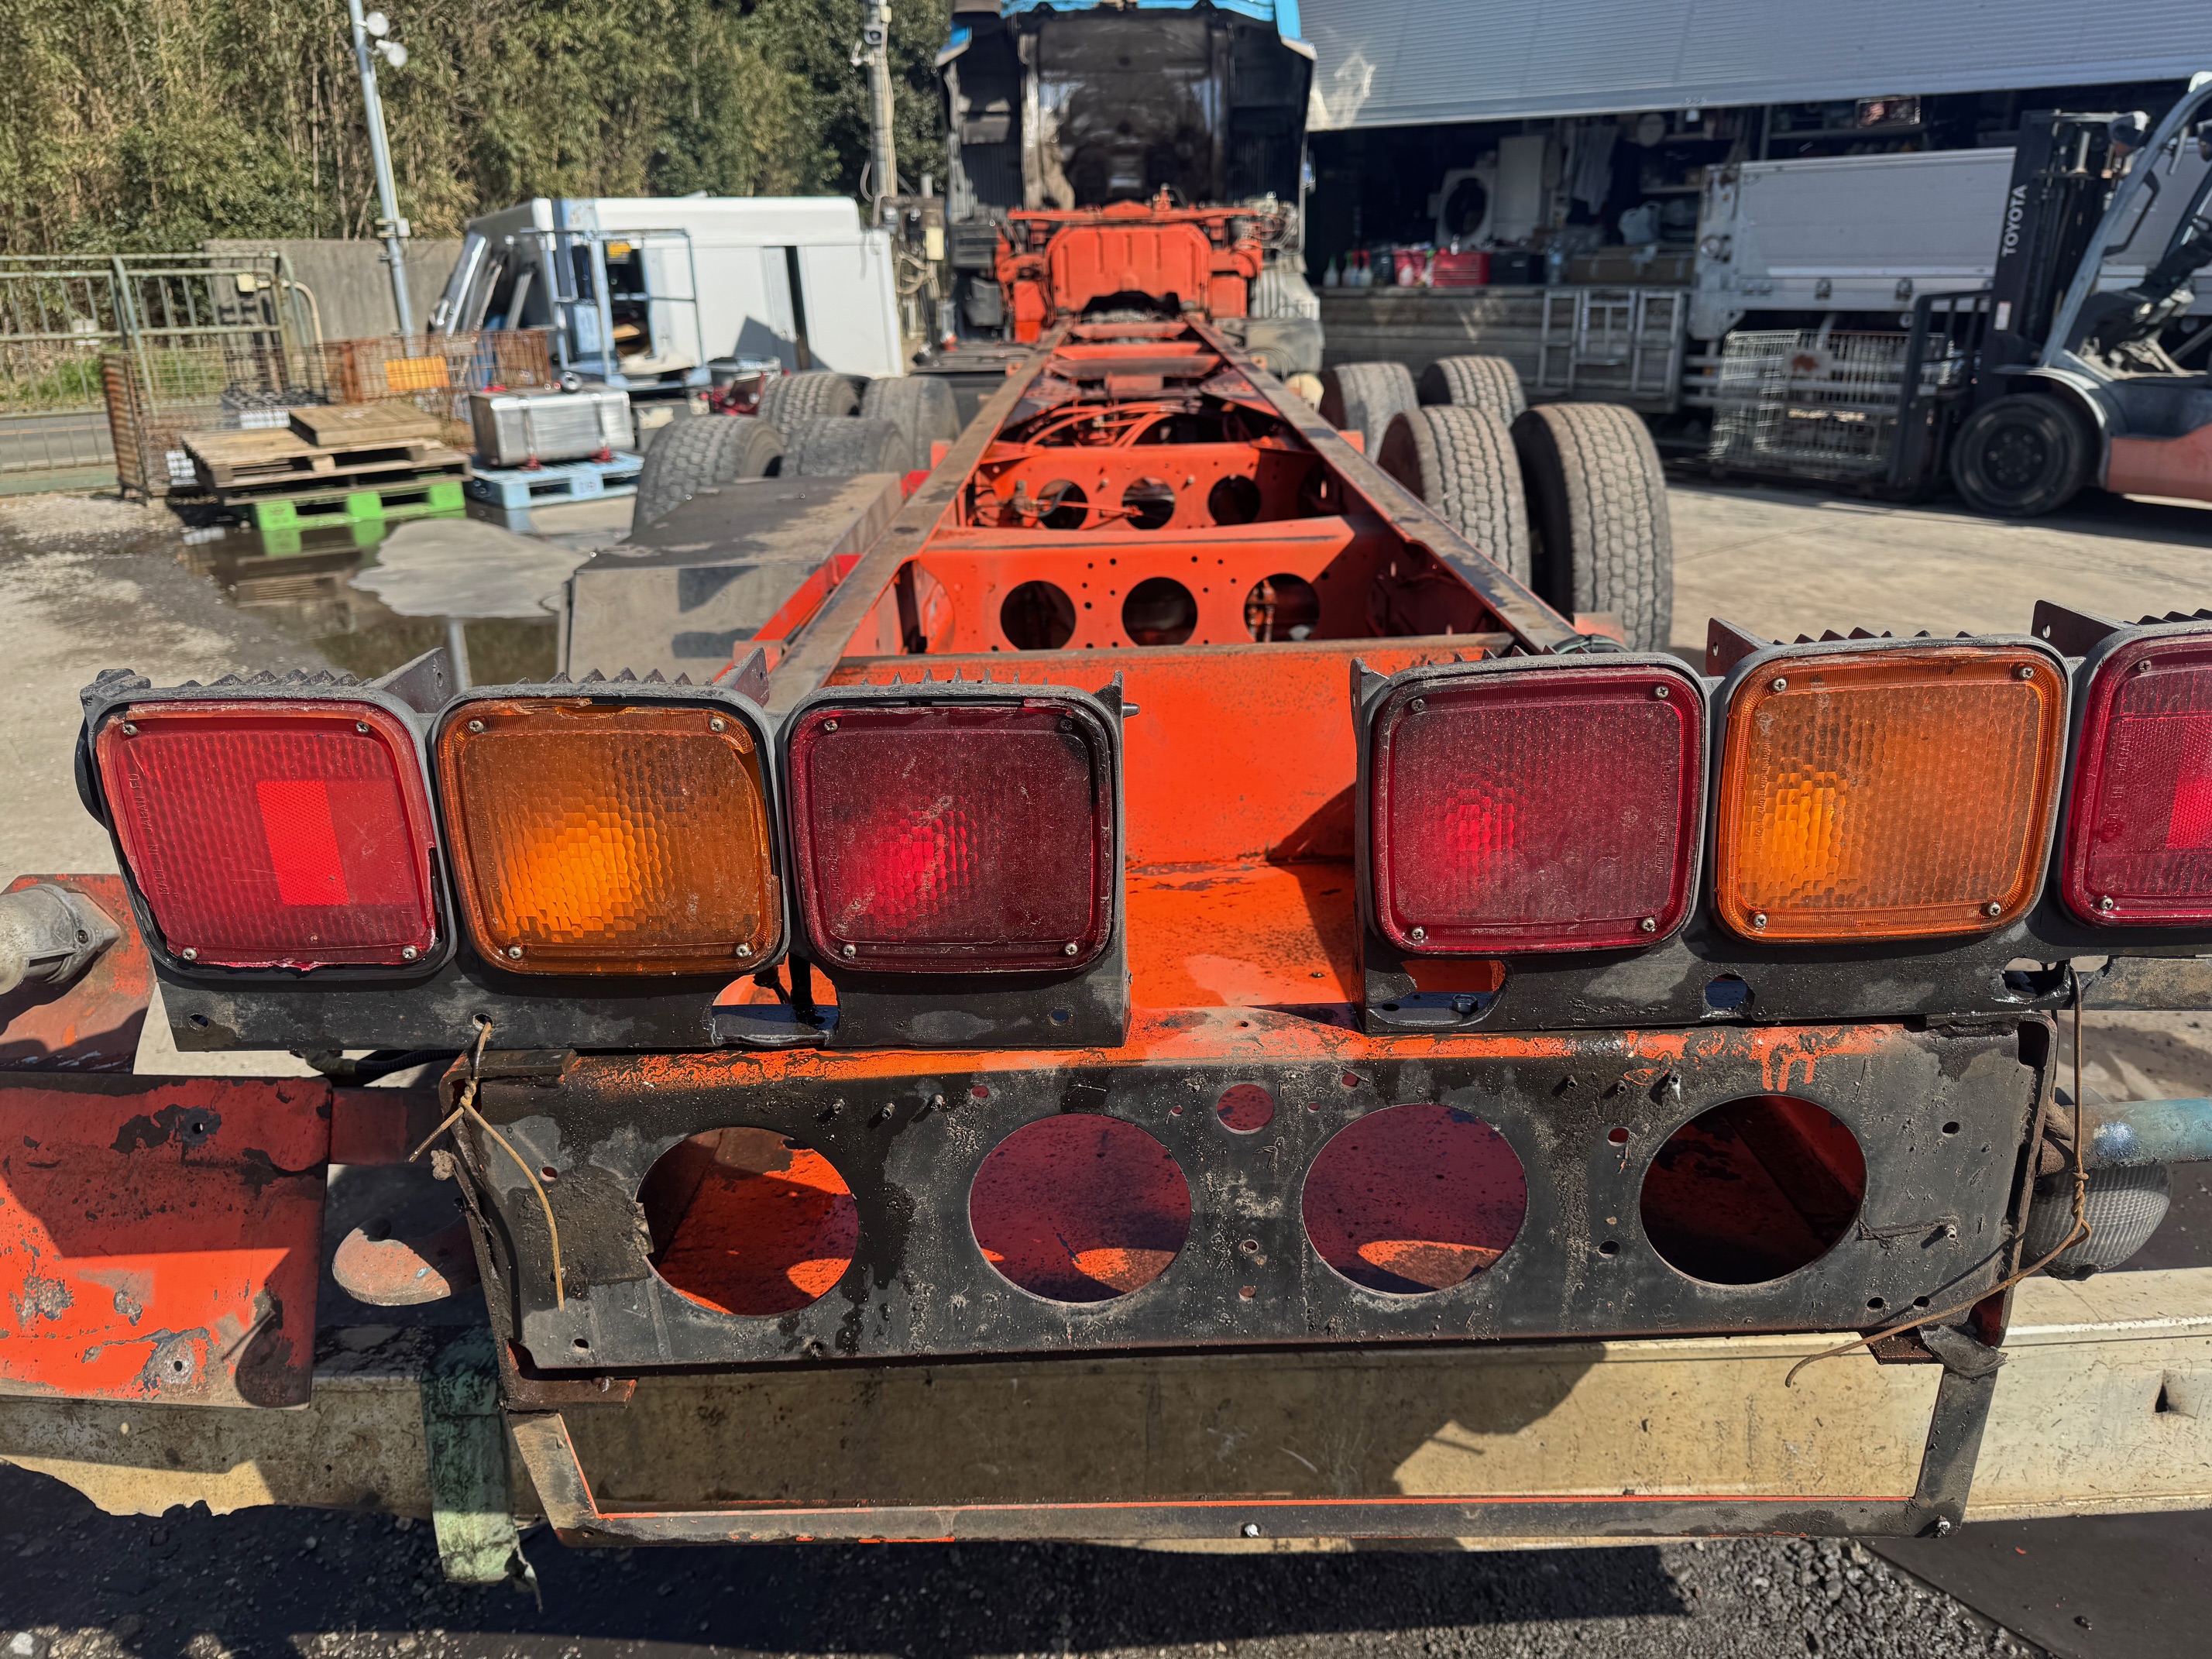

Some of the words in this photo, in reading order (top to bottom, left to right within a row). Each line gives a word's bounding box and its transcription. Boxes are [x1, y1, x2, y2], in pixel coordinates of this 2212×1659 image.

[2001, 184, 2028, 257] TOYOTA
[129, 774, 143, 788] FU
[135, 796, 153, 833] JAPAN
[380, 796, 394, 828] MADE
[147, 843, 159, 855] IN
[386, 836, 399, 847] IN
[153, 868, 170, 895] MADE
[390, 857, 408, 895] JAPAN
[400, 901, 413, 914] FU
